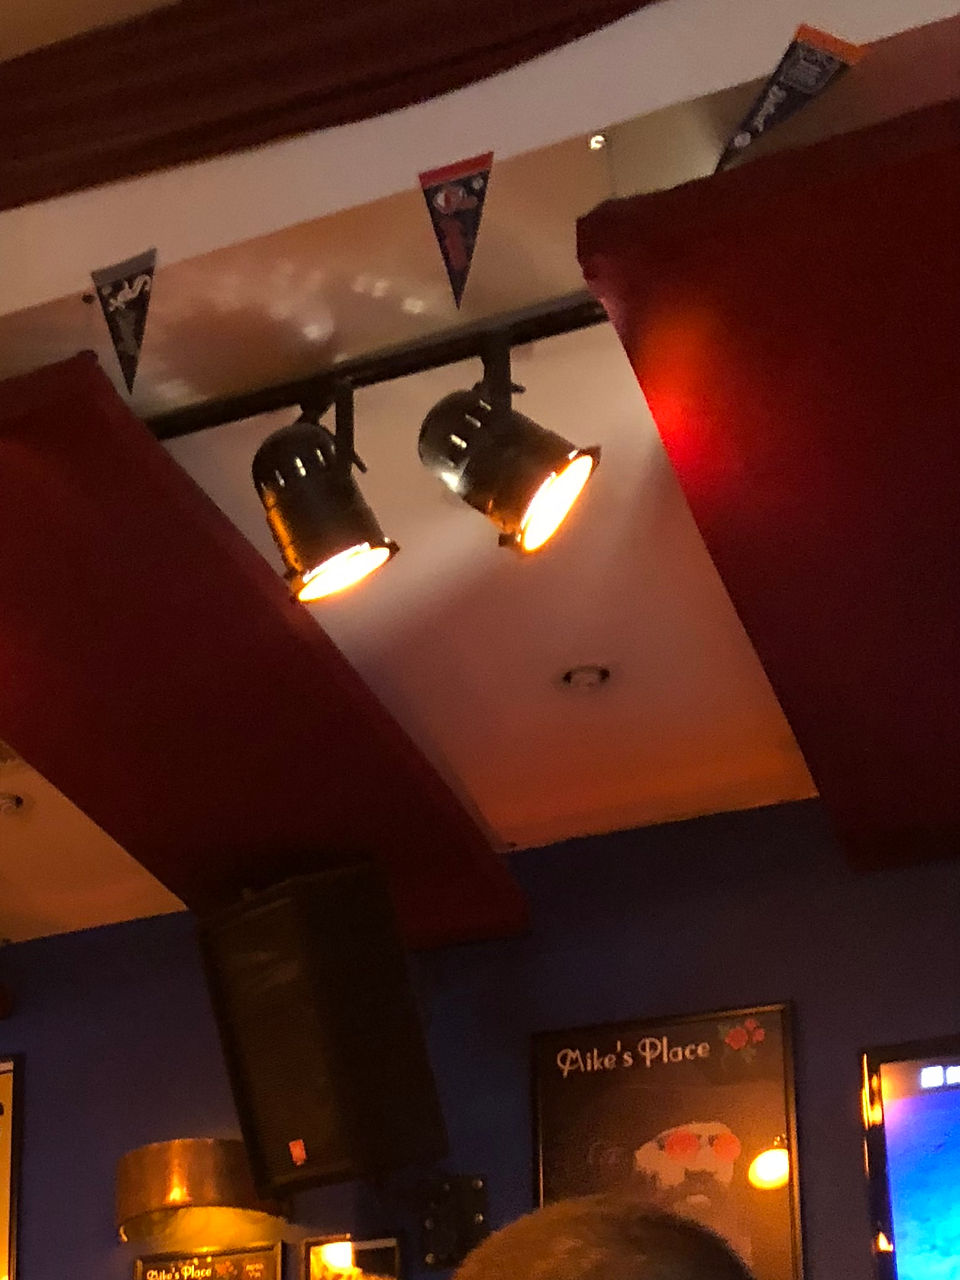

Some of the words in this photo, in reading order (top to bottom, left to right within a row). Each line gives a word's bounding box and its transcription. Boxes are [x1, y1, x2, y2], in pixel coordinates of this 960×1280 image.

[556, 1040, 634, 1078] Mike's
[638, 1036, 710, 1068] Place
[181, 1264, 212, 1280] Place
